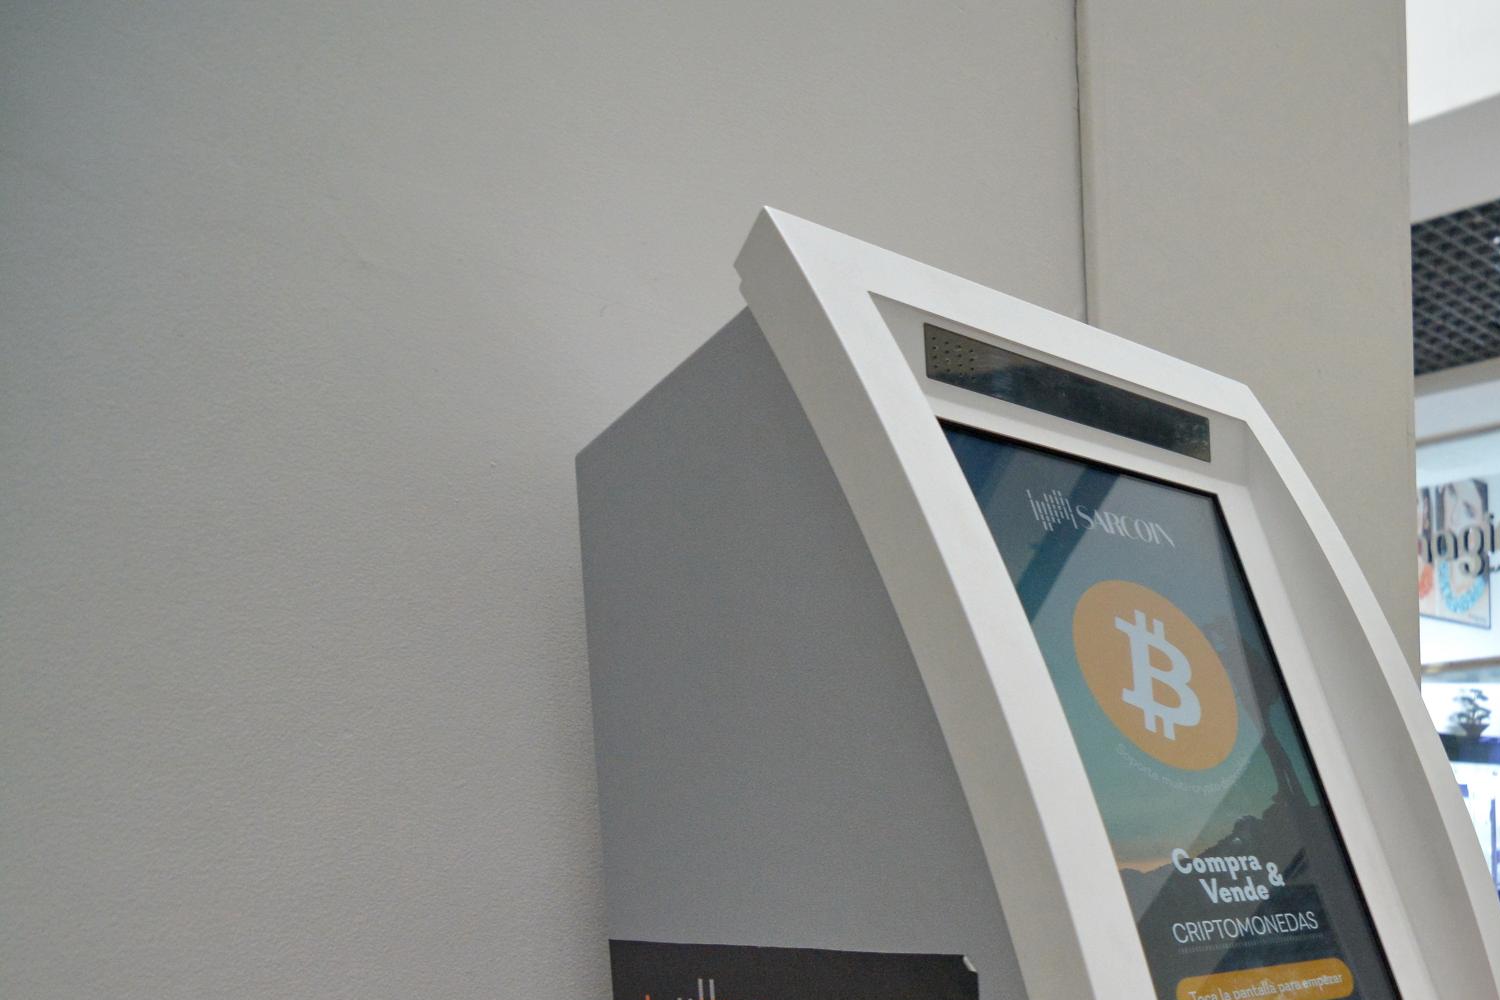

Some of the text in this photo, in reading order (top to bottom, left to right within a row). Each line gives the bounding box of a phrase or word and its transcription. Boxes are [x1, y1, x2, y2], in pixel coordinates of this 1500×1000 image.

[1076, 505, 1176, 549] SARCOIN
[1171, 847, 1286, 887] Compra &
[1198, 876, 1270, 904] Vende
[1172, 910, 1320, 944] CRIPTOMONEDAS
